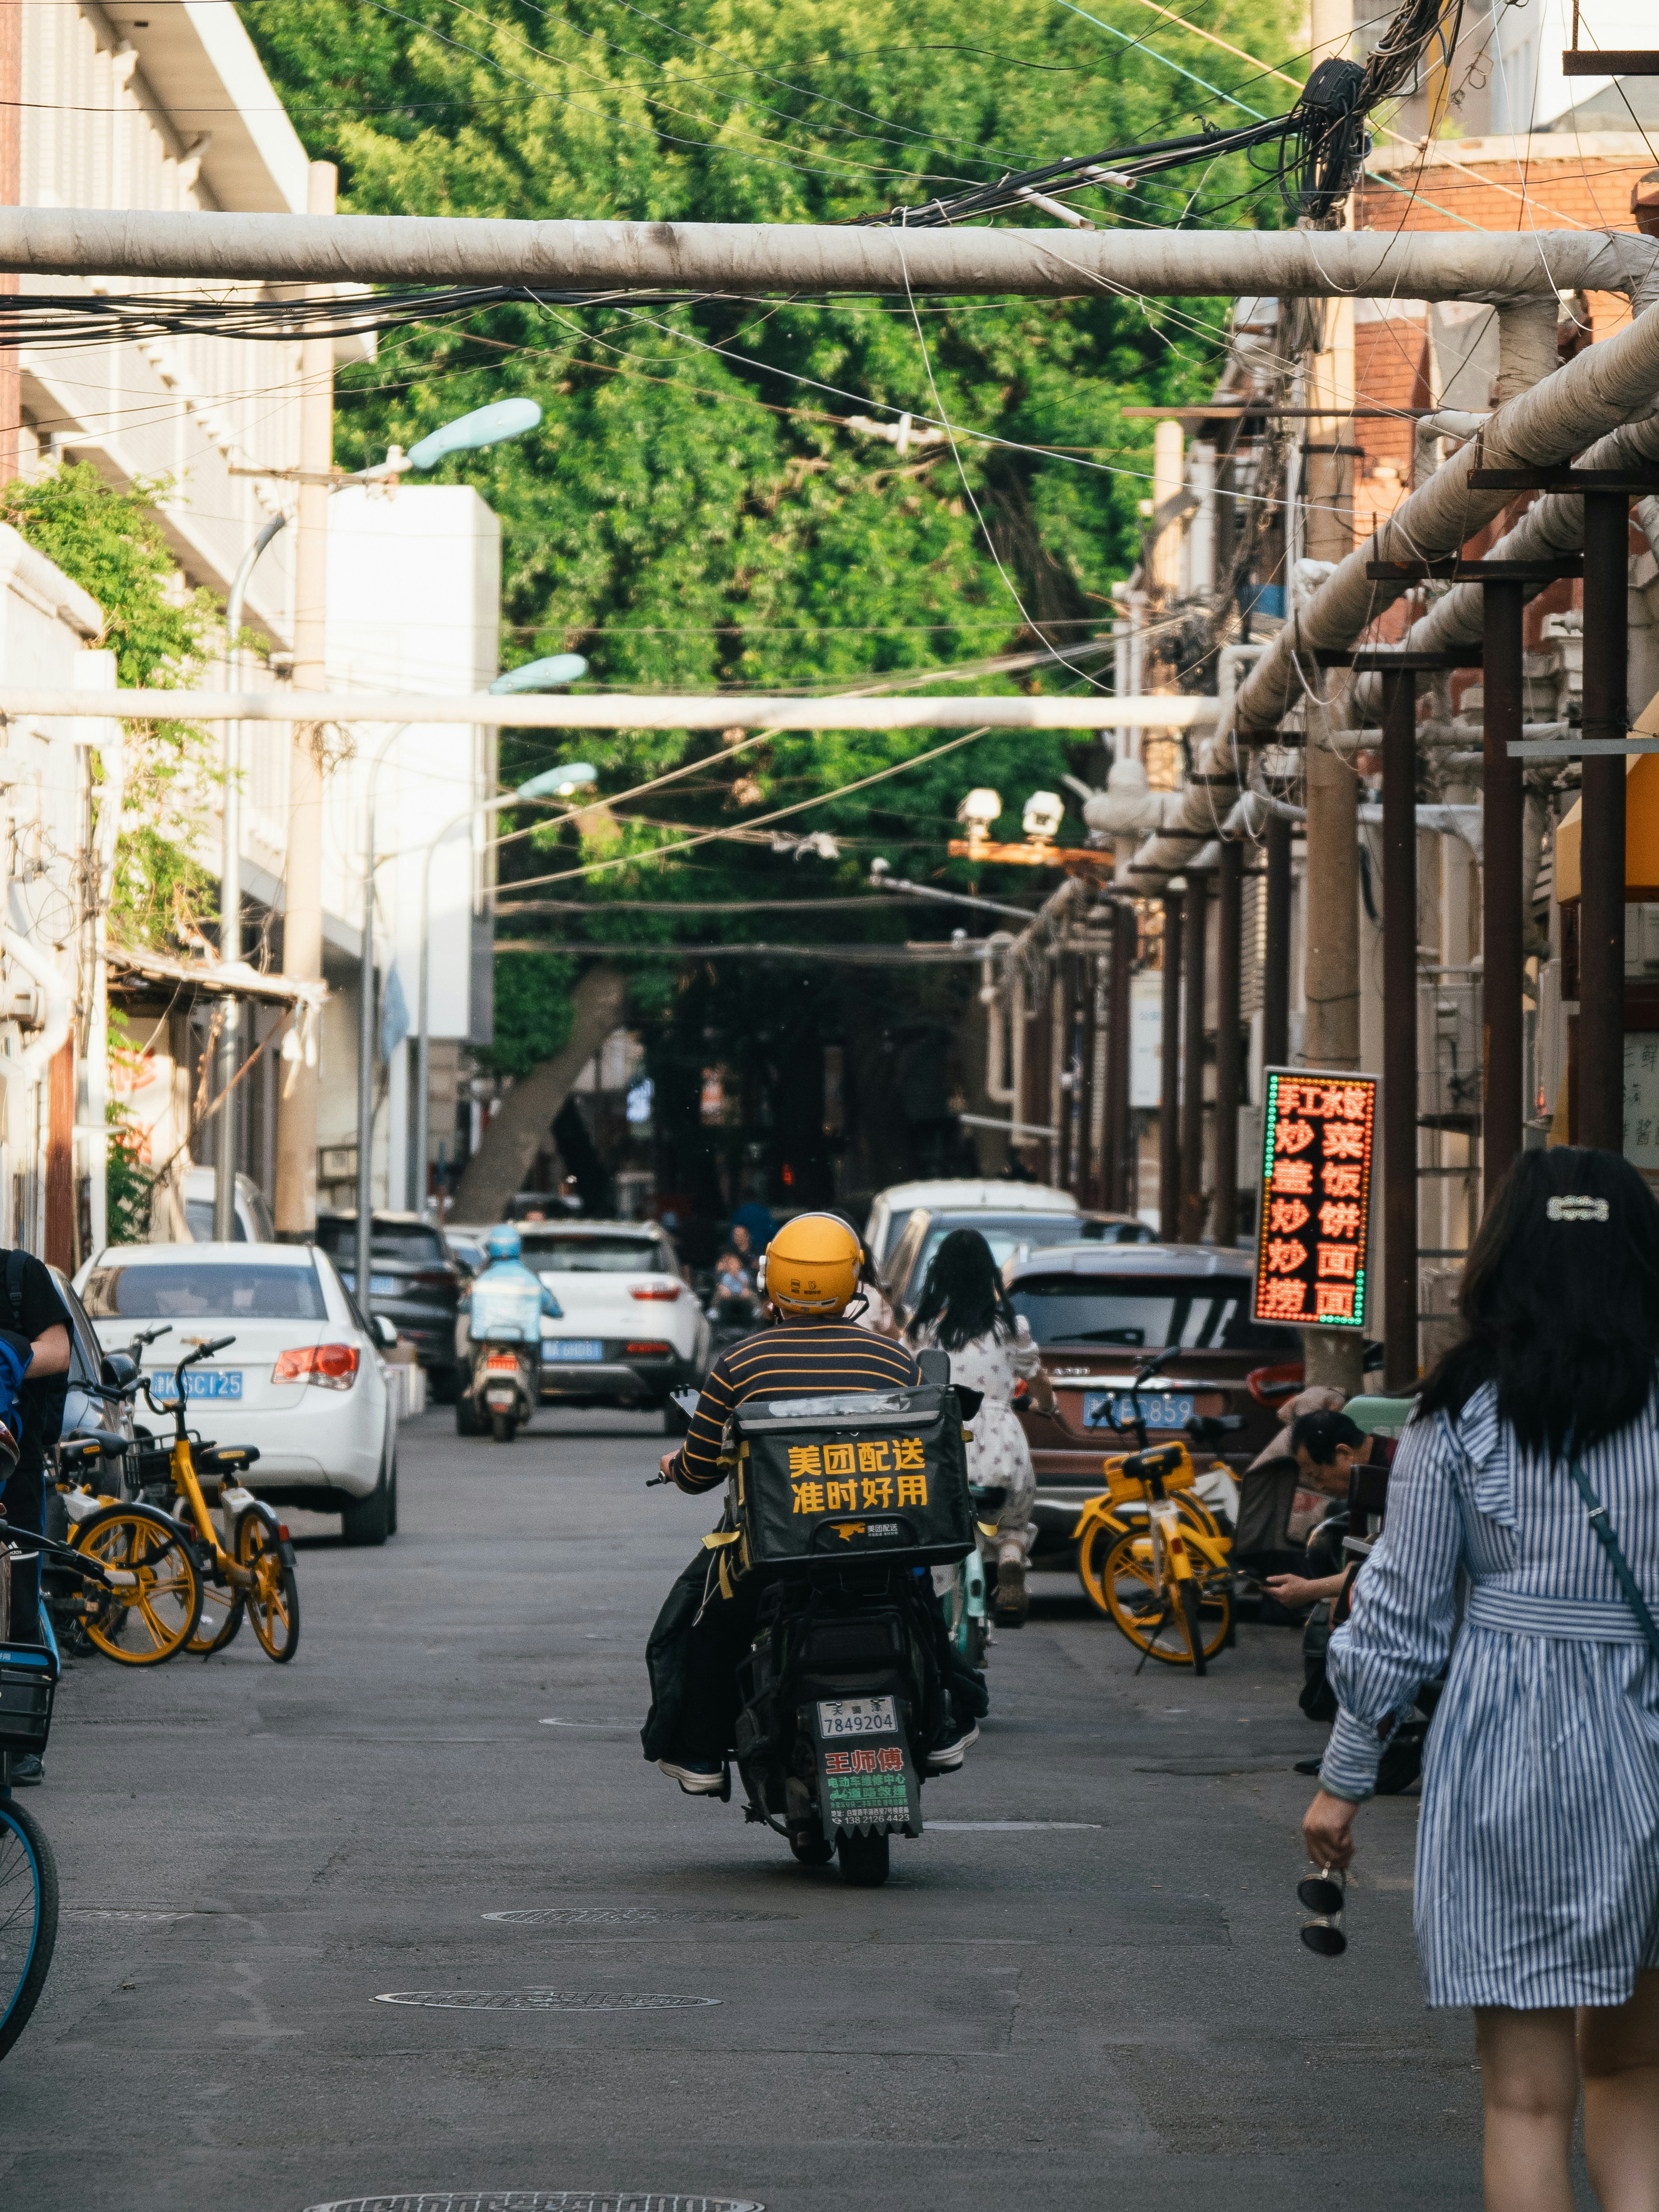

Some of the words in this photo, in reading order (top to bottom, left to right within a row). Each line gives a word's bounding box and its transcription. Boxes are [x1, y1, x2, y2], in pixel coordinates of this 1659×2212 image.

[1275, 1118, 1365, 1158] 炒菜
[1271, 1159, 1362, 1198] 盖饭
[1270, 1198, 1360, 1238] 炒饼
[1268, 1238, 1358, 1278] 炒面
[788, 1437, 926, 1478] 美团配送
[791, 1475, 928, 1514] 准时好用
[867, 1523, 899, 1533] 美团配送
[824, 1714, 893, 1733] 7849204
[825, 1748, 904, 1774] 王师傅
[827, 1773, 906, 1788] 电动车维修中心
[863, 1815, 884, 1823] 2126
